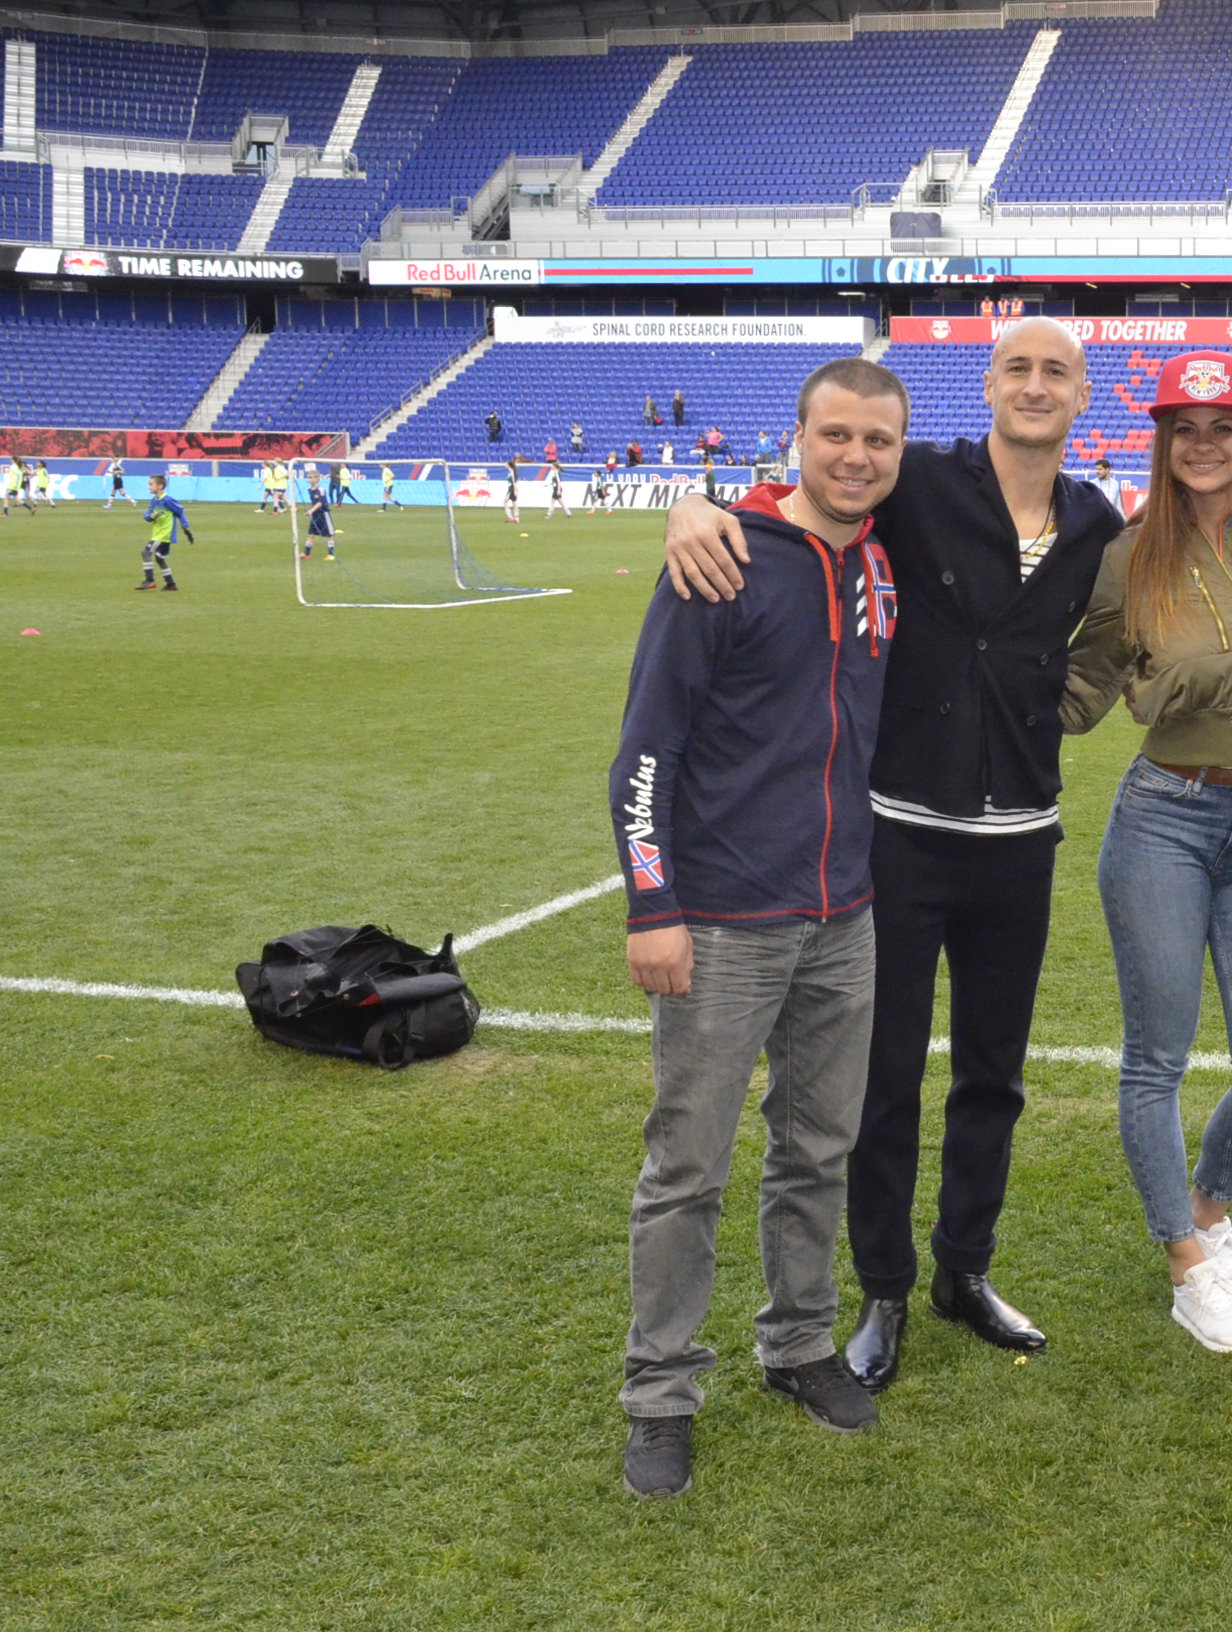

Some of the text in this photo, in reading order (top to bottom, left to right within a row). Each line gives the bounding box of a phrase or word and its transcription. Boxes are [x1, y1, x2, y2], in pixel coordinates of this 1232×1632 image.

[118, 256, 304, 279] TIME REMAINING
[407, 264, 532, 281] Red Bull Arena
[592, 322, 631, 337] SPINAL
[635, 322, 665, 337] CORD
[669, 322, 728, 337] RESEARCH
[732, 322, 807, 337] FOUNDATION.
[1101, 320, 1188, 341] TOGETHER
[624, 754, 659, 850] Nebulus
